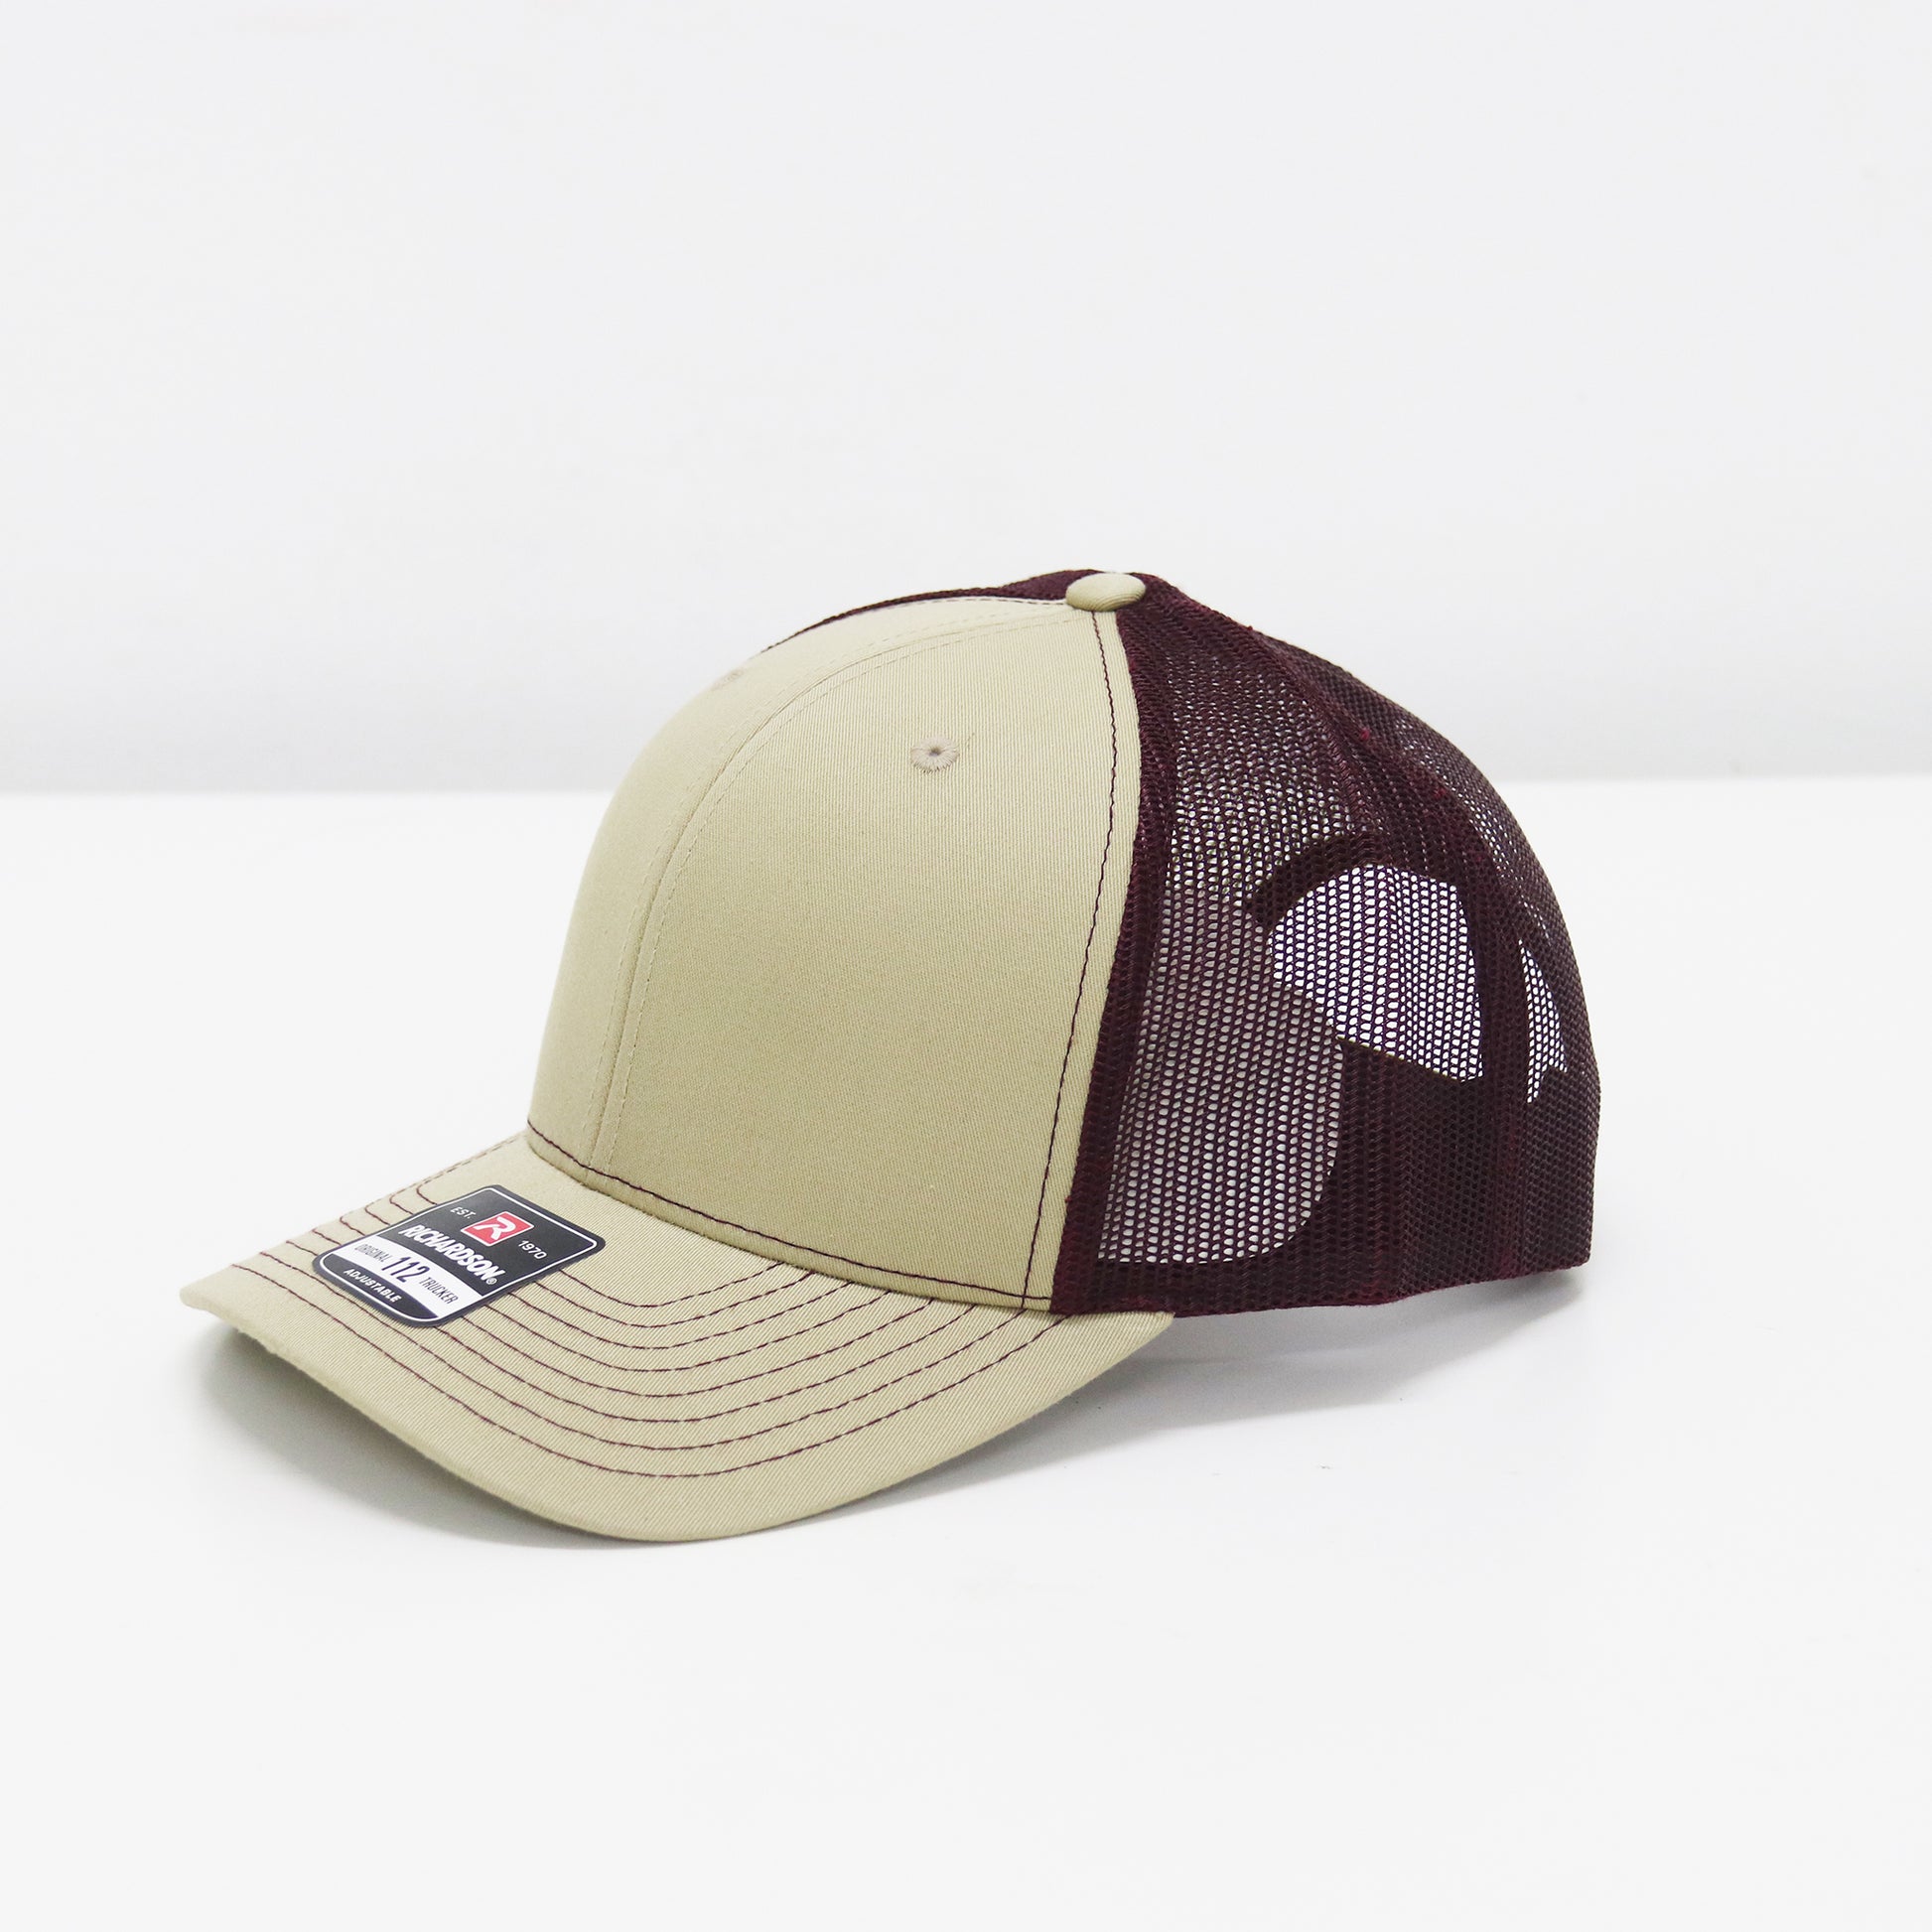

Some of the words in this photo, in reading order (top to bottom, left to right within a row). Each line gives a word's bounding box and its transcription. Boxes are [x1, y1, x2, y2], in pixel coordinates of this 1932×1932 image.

[450, 1206, 477, 1219] EST.
[518, 1240, 548, 1260] 1970
[344, 1268, 402, 1303] ADJUSTABLE
[353, 1243, 394, 1263] ORIGINAL
[381, 1256, 431, 1283] 112
[419, 1277, 460, 1305] TRUCKER
